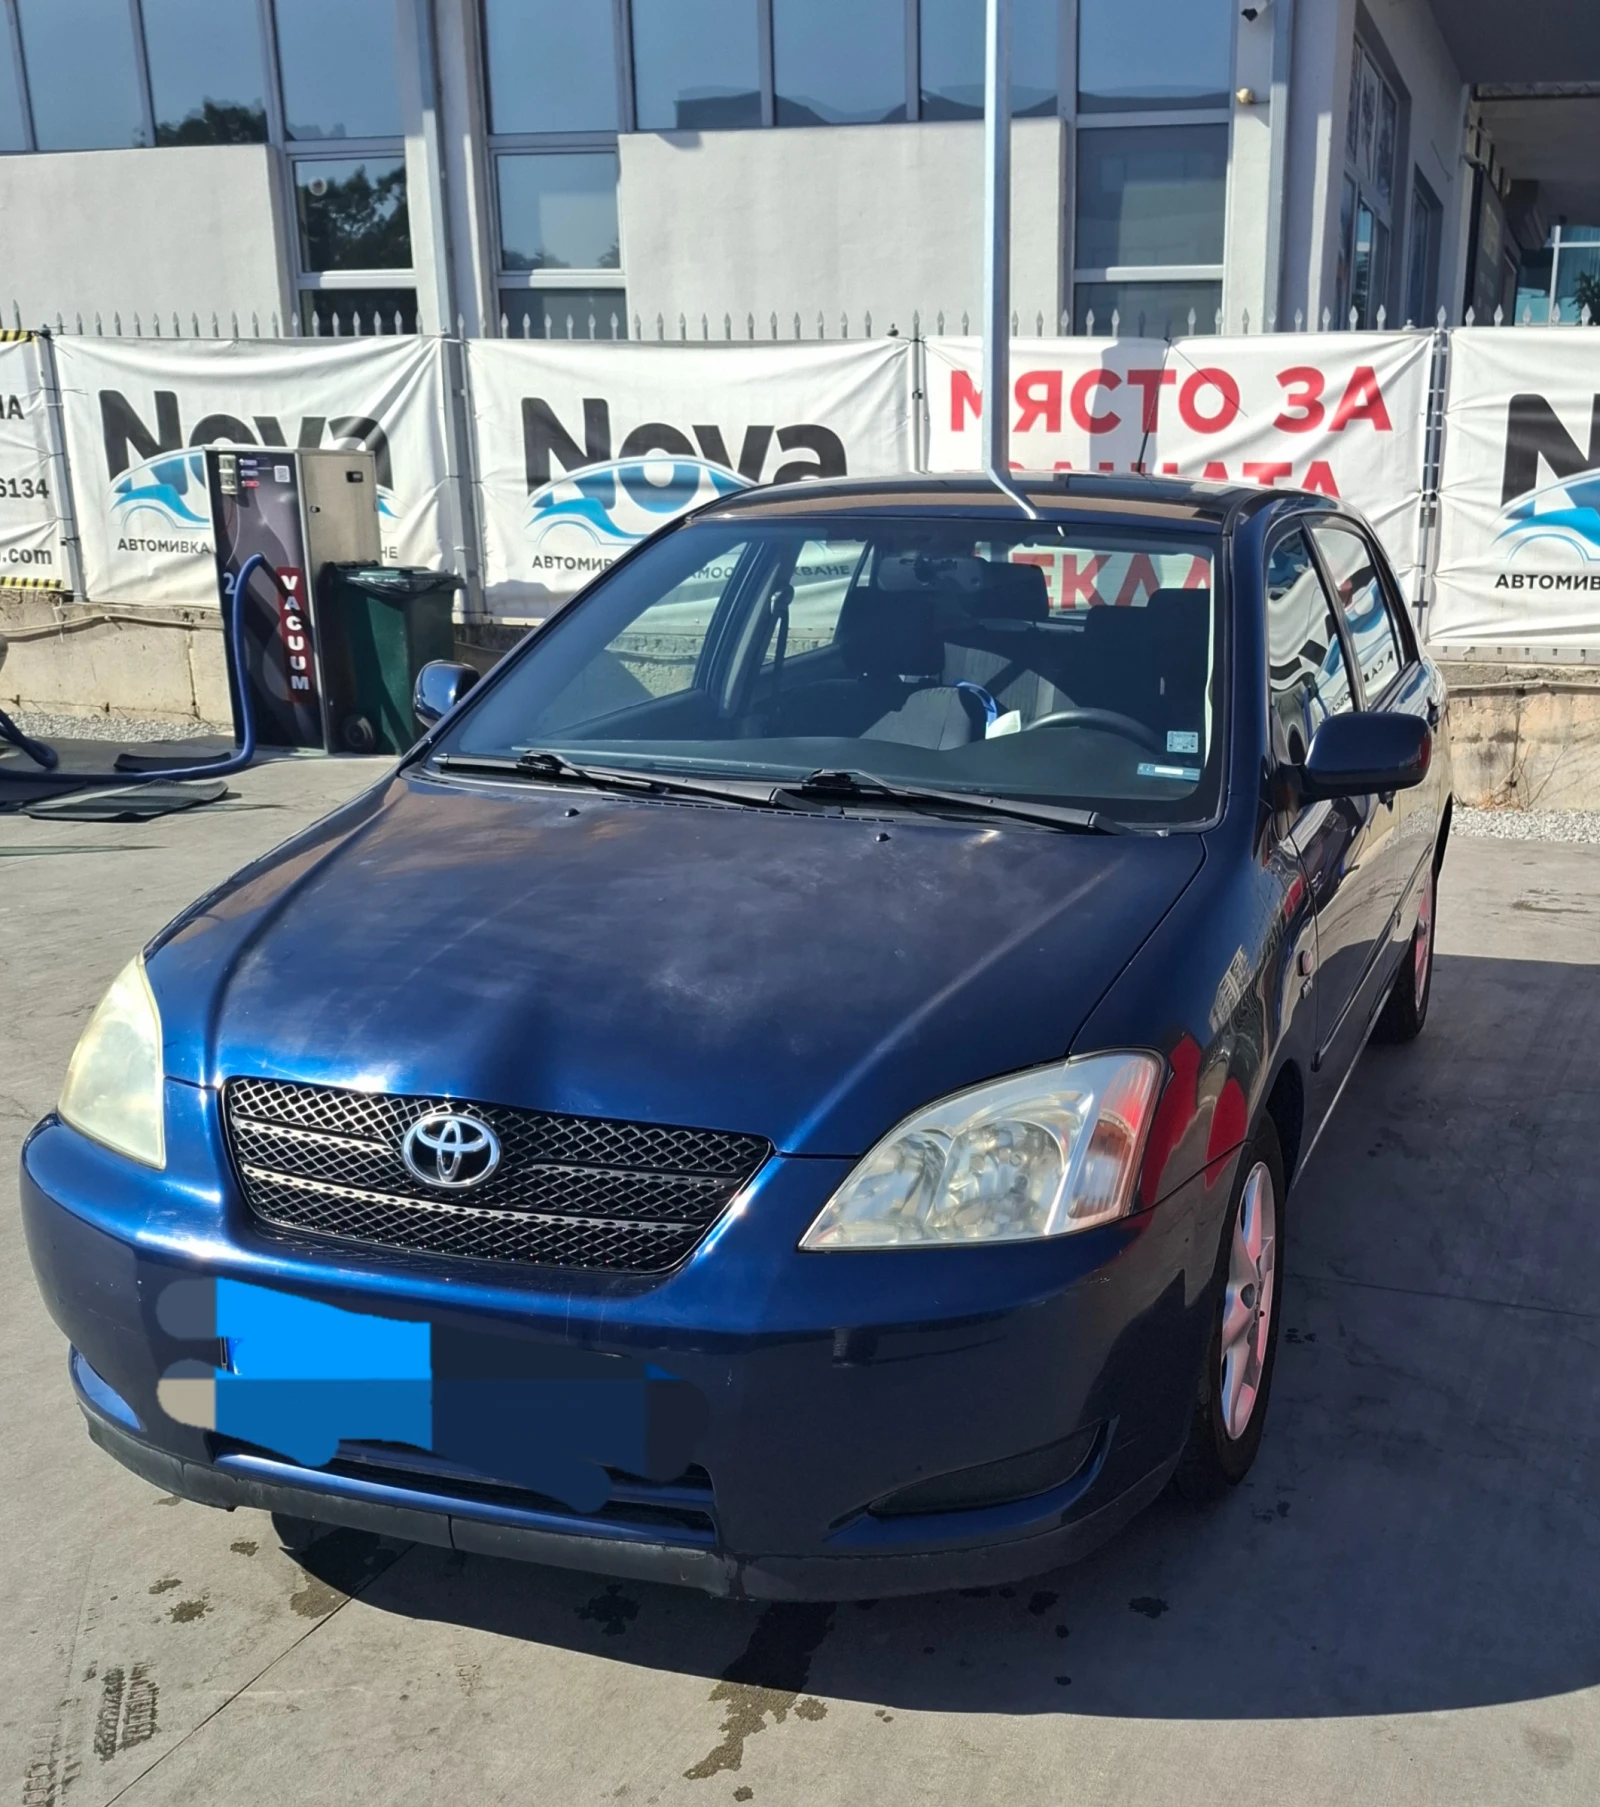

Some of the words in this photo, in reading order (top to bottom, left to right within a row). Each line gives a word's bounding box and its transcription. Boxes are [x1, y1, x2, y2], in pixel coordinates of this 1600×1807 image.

[950, 368, 1240, 434] МЯСТО
[1274, 366, 1393, 432] ЗА
[117, 537, 212, 555] АВТОМИВКА
[280, 574, 310, 690] VACUUM
